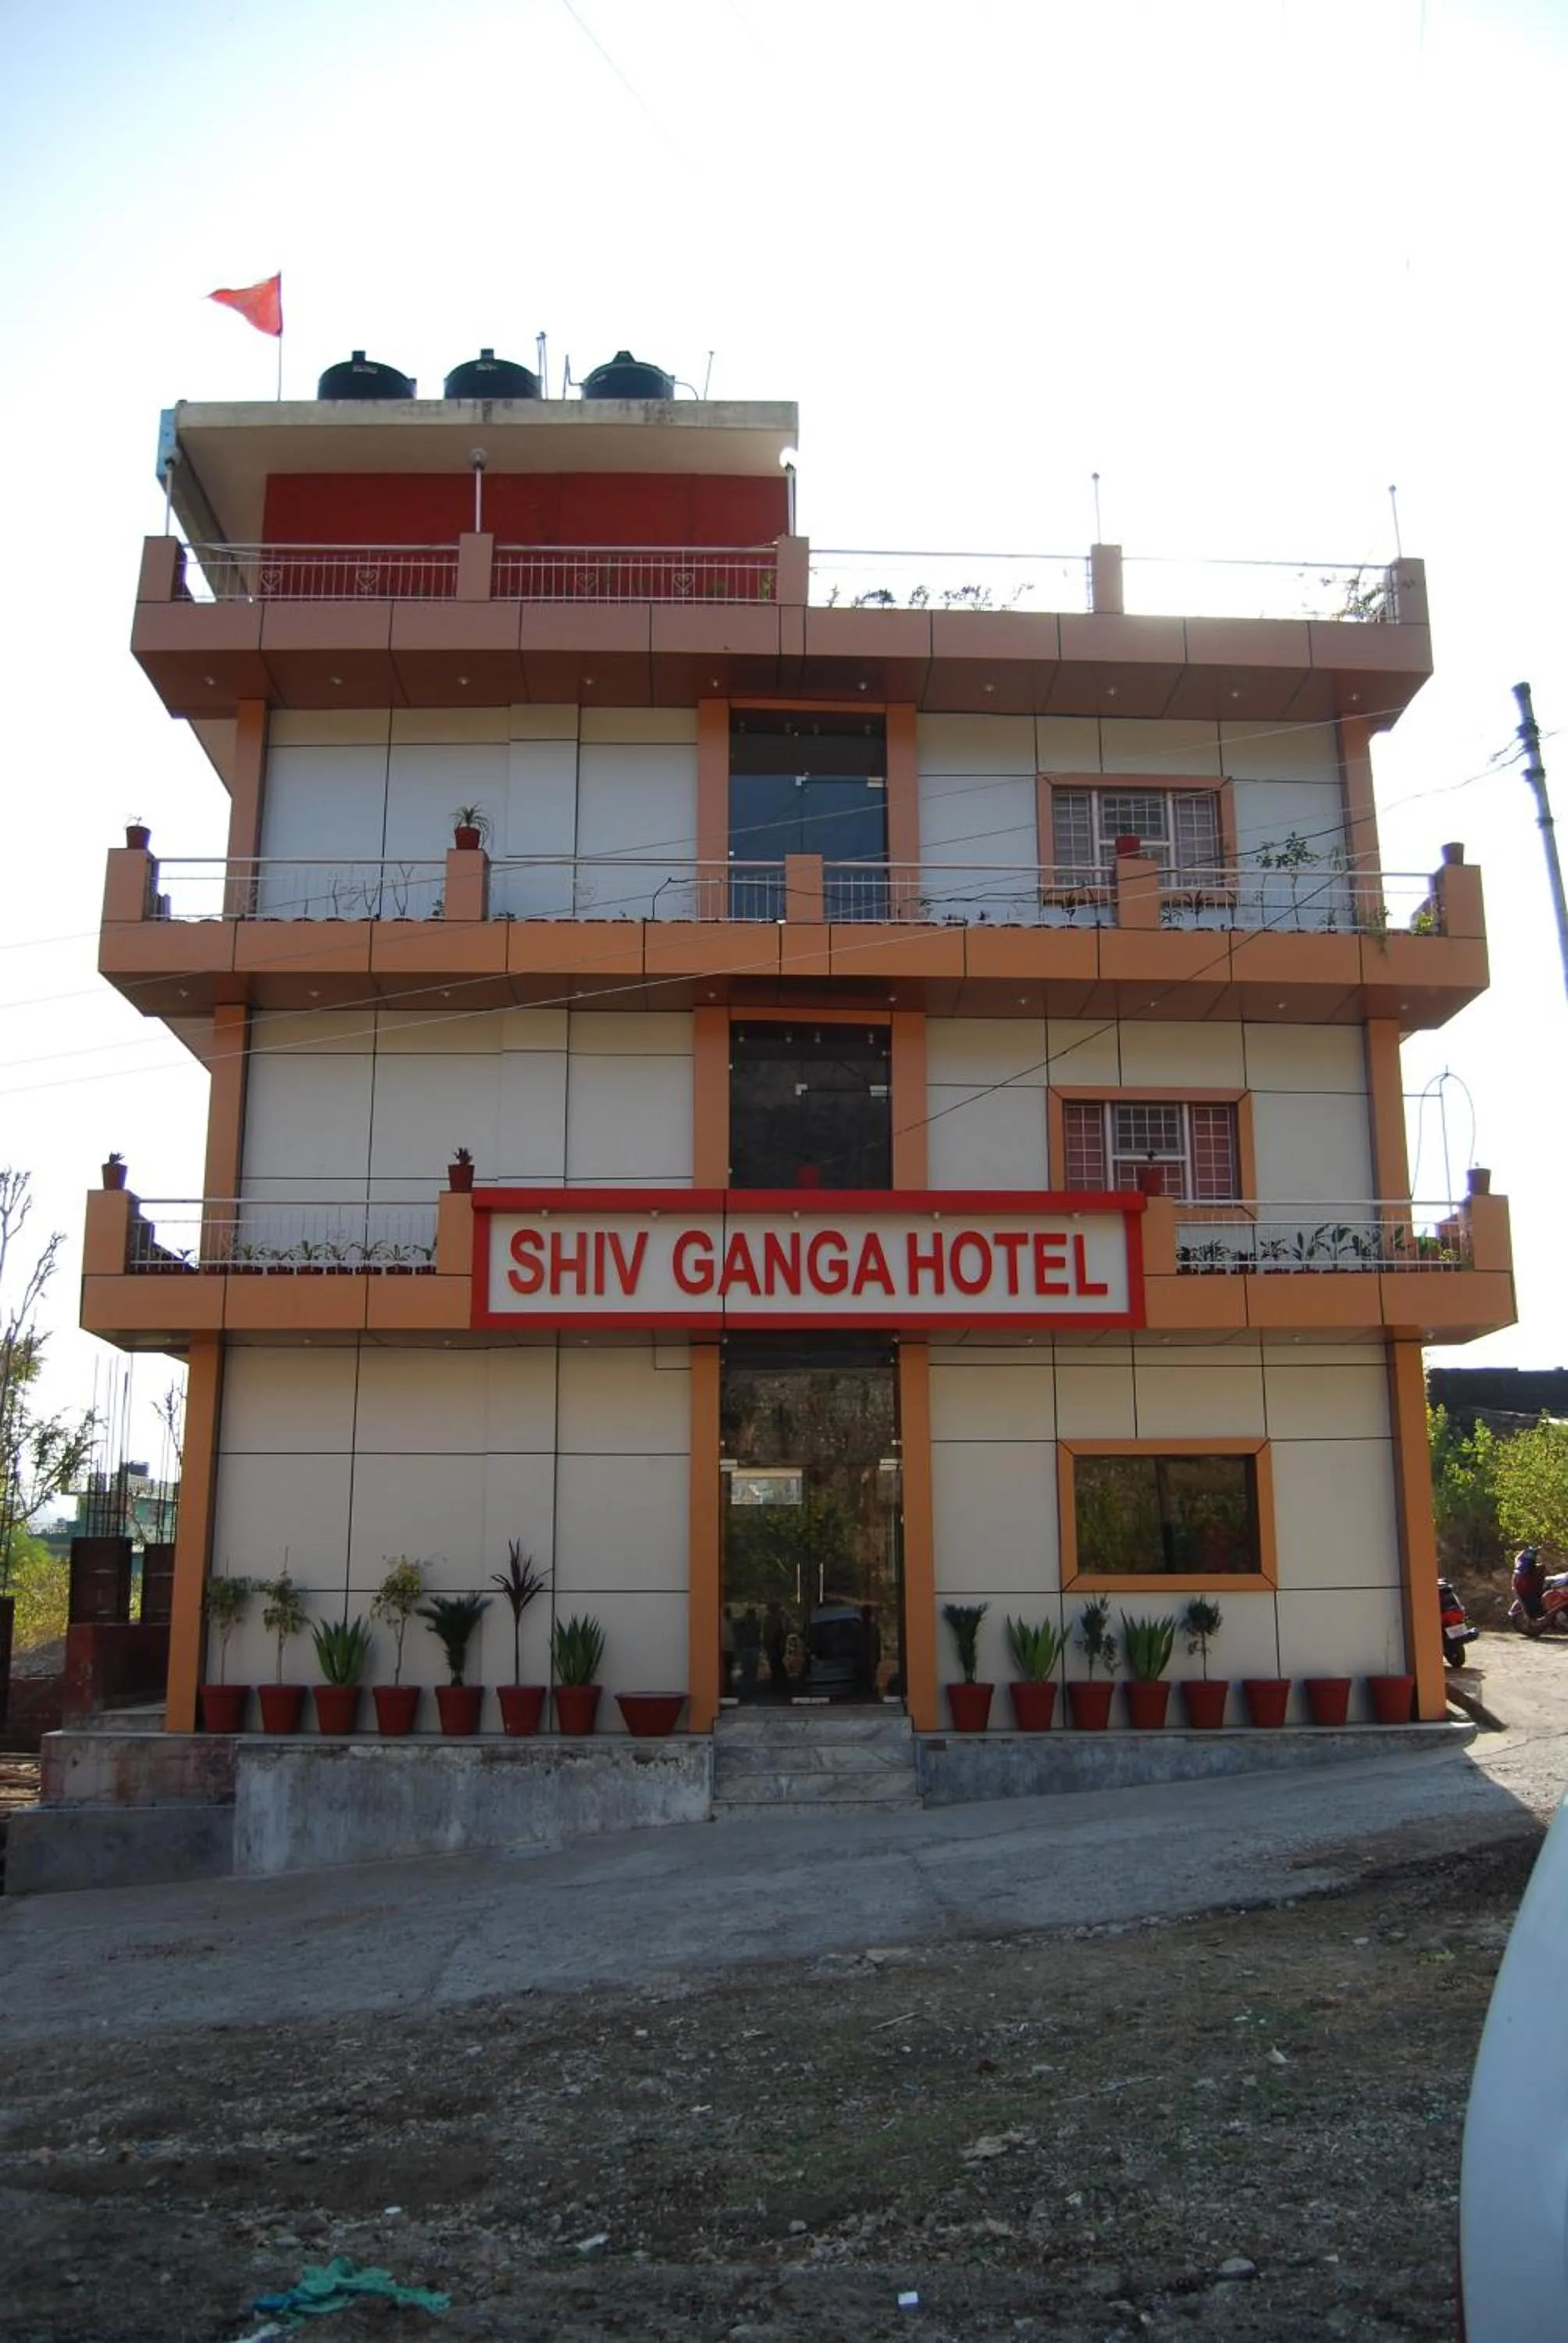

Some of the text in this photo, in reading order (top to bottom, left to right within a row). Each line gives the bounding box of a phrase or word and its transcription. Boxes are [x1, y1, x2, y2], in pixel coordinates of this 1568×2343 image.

[508, 1228, 1110, 1297] SHIV GANGA HOTEL
